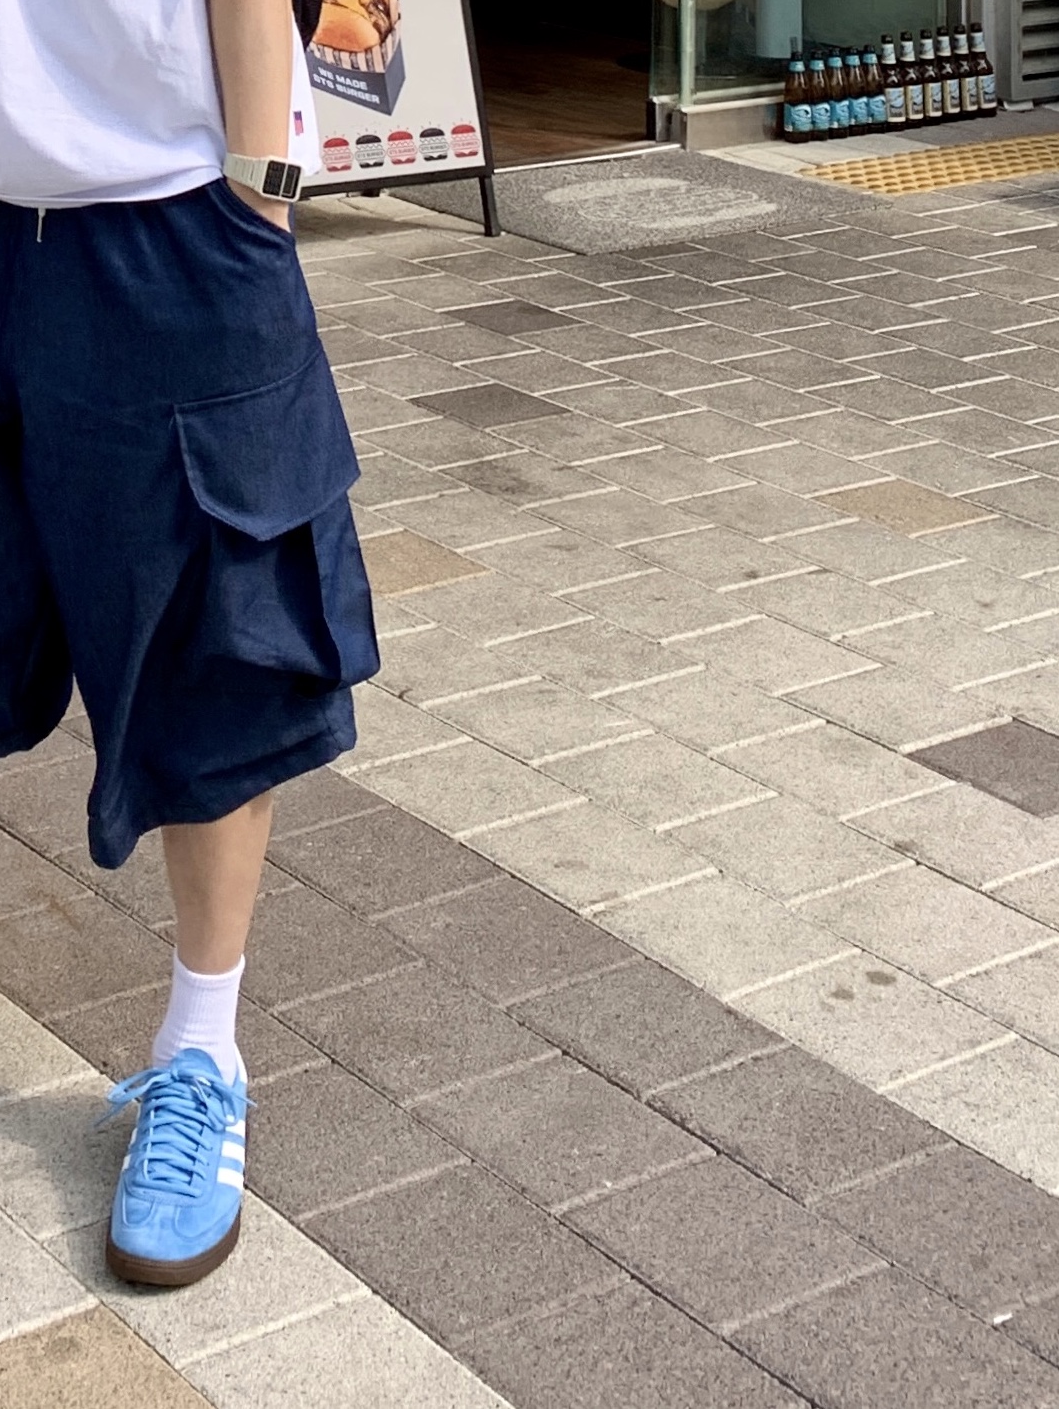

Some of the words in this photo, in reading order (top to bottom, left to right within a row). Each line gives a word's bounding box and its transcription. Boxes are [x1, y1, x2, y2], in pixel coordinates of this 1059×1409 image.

[317, 66, 334, 81] WE
[336, 75, 368, 90] MADE
[336, 83, 380, 104] BURGER
